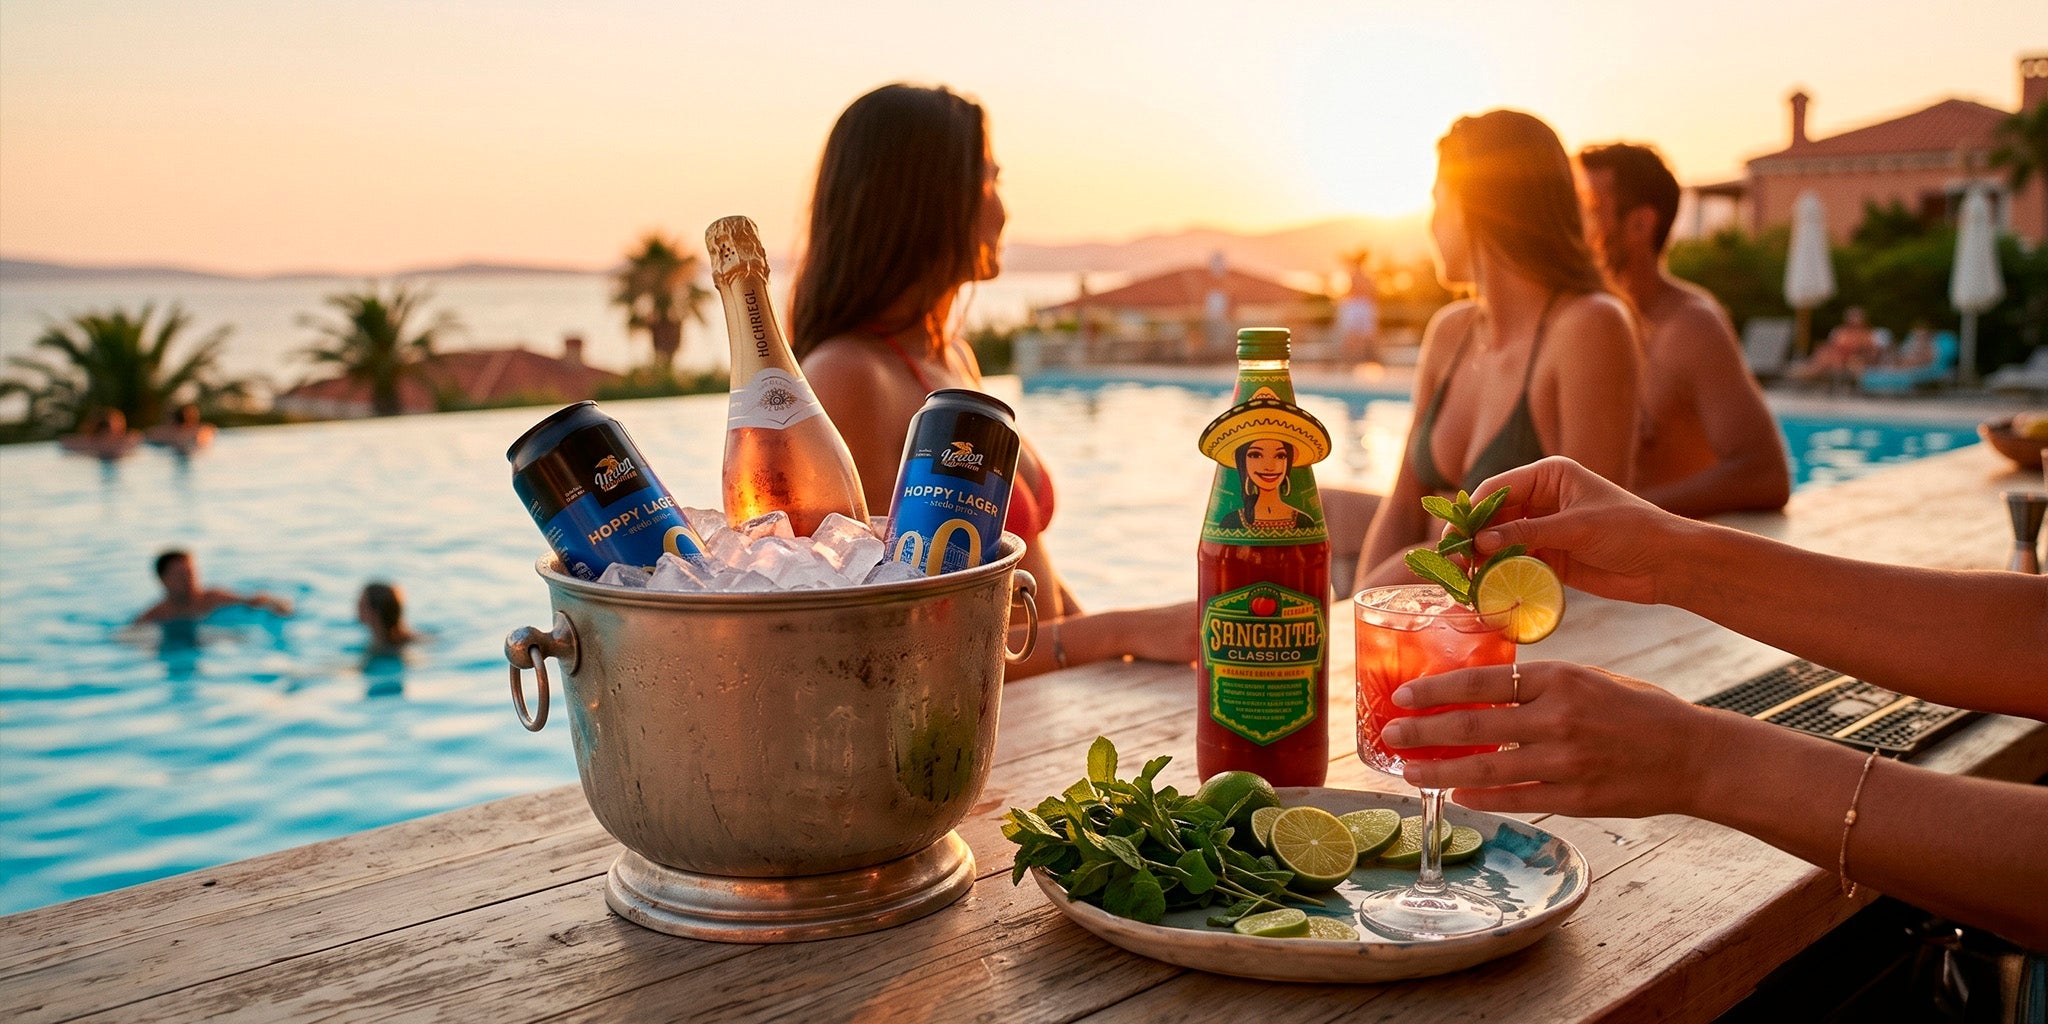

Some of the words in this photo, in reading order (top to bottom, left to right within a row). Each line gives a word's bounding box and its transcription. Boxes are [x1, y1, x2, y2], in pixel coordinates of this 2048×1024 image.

[745, 289, 770, 358] HOCHRIEGL
[903, 485, 954, 500] HOPPY
[957, 491, 999, 517] LAGER
[587, 507, 640, 546] HOPPY
[642, 496, 675, 515] LAGE
[1210, 618, 1322, 651] SANGRITA
[1227, 649, 1301, 662] CLASSICO
